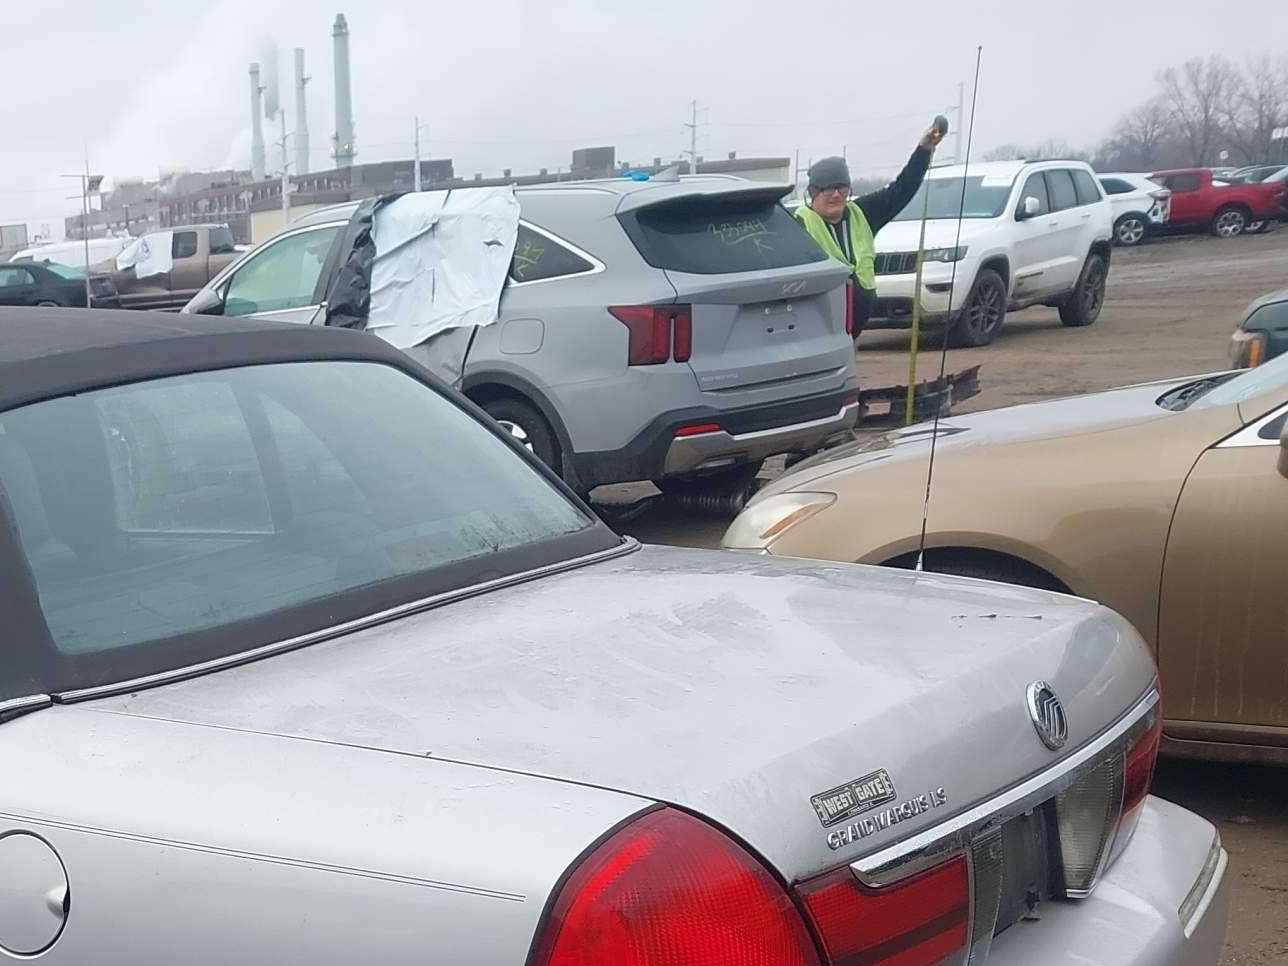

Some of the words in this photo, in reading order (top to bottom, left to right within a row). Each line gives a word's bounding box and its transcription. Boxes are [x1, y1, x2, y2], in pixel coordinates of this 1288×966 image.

[822, 791, 855, 816] WEST
[854, 777, 886, 801] GATE
[827, 819, 875, 850] GRAND
[872, 794, 929, 832] MARQUIS
[929, 787, 948, 809] LS
